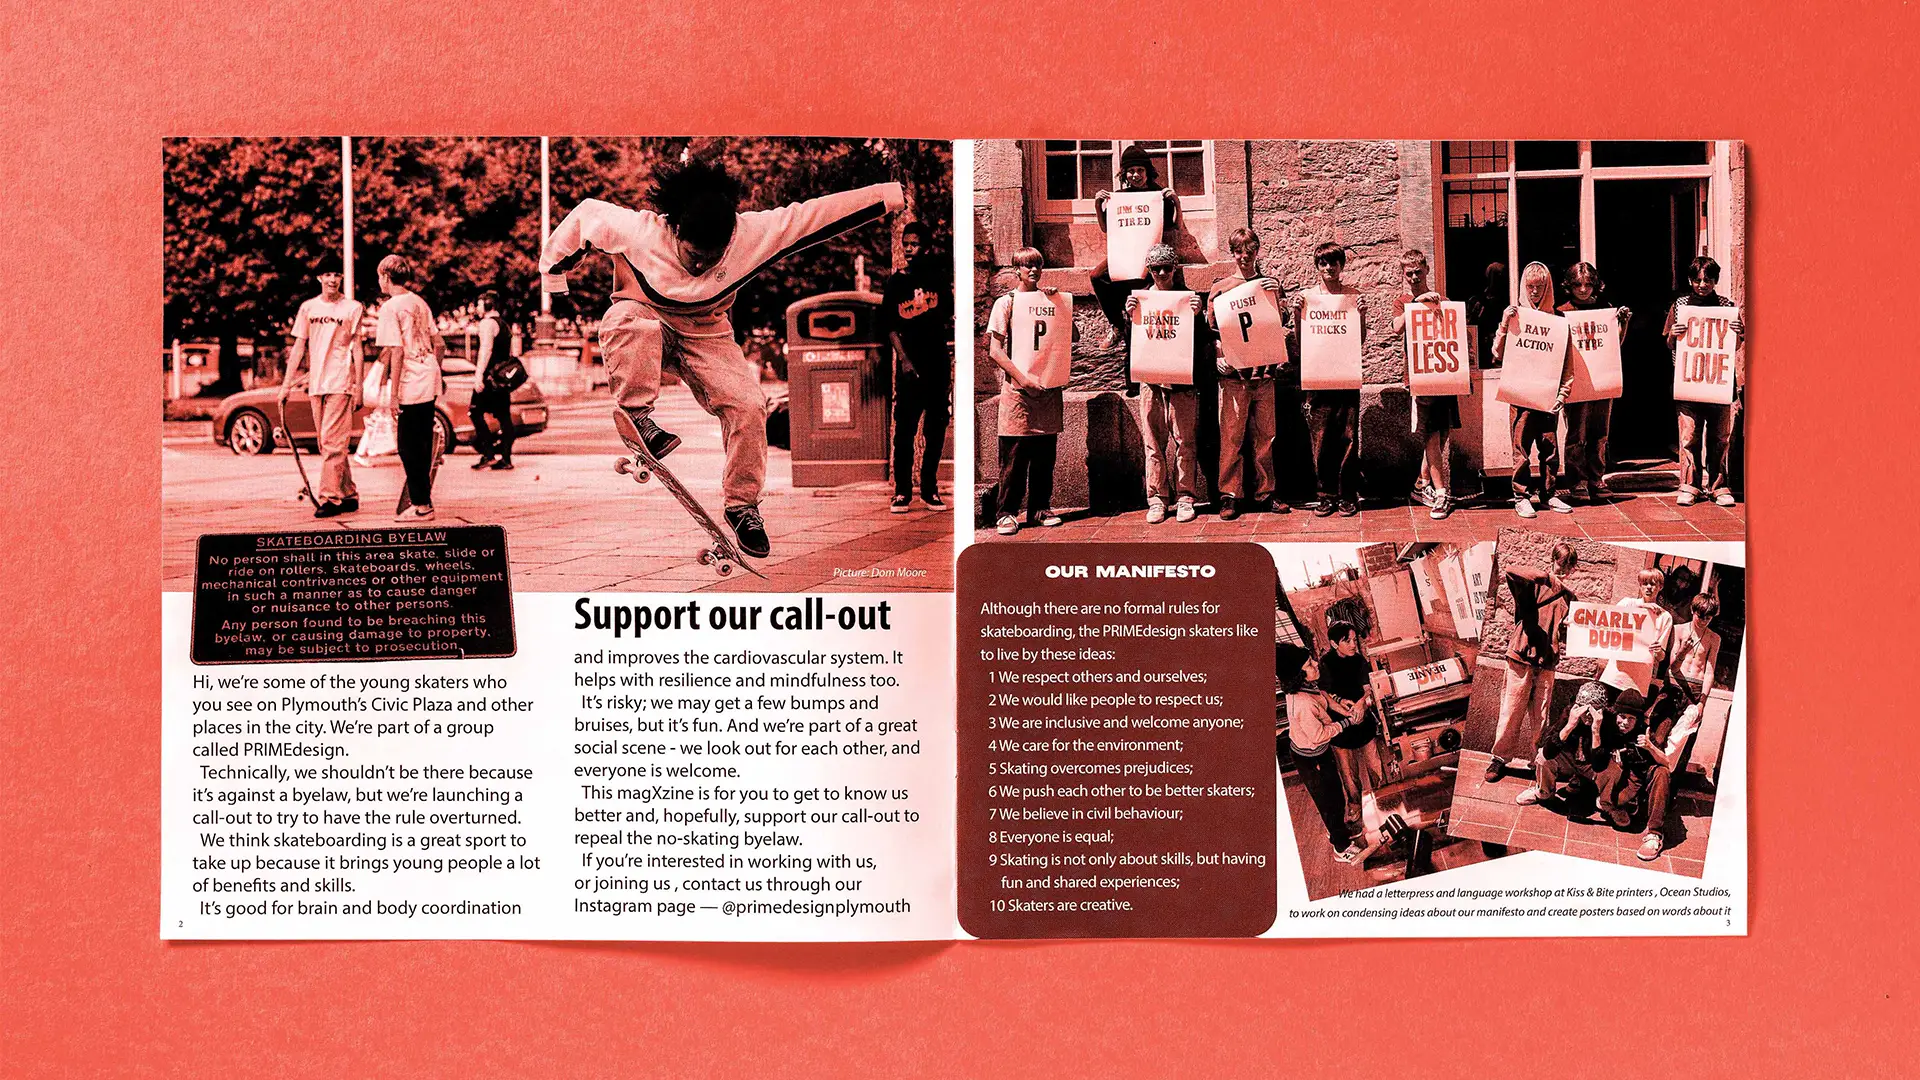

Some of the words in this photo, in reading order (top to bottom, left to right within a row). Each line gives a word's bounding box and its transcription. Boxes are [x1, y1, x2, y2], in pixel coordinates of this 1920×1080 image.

[1118, 217, 1151, 227] TIRED
[1029, 306, 1055, 316] PUSH
[1230, 296, 1256, 310] PUSH
[1143, 315, 1180, 326] BEANIE
[1310, 310, 1348, 320] COMMIT
[1238, 312, 1253, 342] P
[1310, 325, 1347, 335] TRICKS
[1411, 309, 1457, 341] FEAR
[1525, 324, 1550, 336] RAW
[1687, 316, 1729, 349] CITY
[1034, 320, 1047, 351] P
[1146, 329, 1177, 339] WARS
[1516, 338, 1554, 352] ACTION
[1413, 341, 1459, 374] LESS
[256, 533, 382, 547] SKATEBOARDING
[388, 531, 446, 543] BYELAW
[832, 567, 870, 577] Picture:
[870, 567, 894, 577] Dom
[896, 567, 926, 577] Moore
[1044, 565, 1088, 578] OUR
[1096, 564, 1216, 577] MANIFESTO
[227, 591, 239, 601] in
[244, 590, 275, 601] such
[280, 591, 287, 600] a
[292, 590, 342, 599] manner
[347, 589, 362, 598] as
[367, 587, 381, 597] to
[386, 588, 425, 596] cause
[430, 584, 477, 597] danger
[251, 605, 266, 613] or
[271, 601, 330, 613] nuisance
[335, 600, 349, 611] to
[354, 599, 390, 610] other
[396, 599, 453, 611] persons.
[221, 619, 246, 632] Any
[251, 620, 297, 631] person
[302, 616, 342, 627] found
[347, 616, 361, 626] to
[367, 615, 383, 626] be
[388, 613, 455, 627] breaching
[460, 612, 486, 623] this
[574, 597, 700, 638] Support
[708, 606, 762, 630] our
[770, 597, 891, 630] call-out
[1574, 608, 1647, 631] GNARLY
[980, 624, 1075, 640] skateboarding,
[1078, 624, 1100, 637] the
[1102, 624, 1186, 640] PRIMEdesign
[1188, 623, 1233, 636] skaters
[1236, 623, 1258, 636] like
[245, 647, 272, 657] may
[278, 644, 294, 654] be
[299, 642, 350, 655] subject
[355, 642, 369, 652] to
[375, 641, 461, 654] prosecution.
[574, 649, 602, 663] and
[608, 650, 679, 667] improves
[683, 649, 709, 664] the
[713, 650, 826, 664] cardiovascular
[830, 651, 888, 668] system.
[893, 650, 903, 664] It
[574, 671, 616, 689] helps
[620, 672, 653, 686] with
[659, 672, 731, 687] resilience
[735, 672, 764, 687] and
[770, 672, 866, 687] mindfulness
[869, 674, 899, 686] too.
[192, 741, 238, 756] called
[244, 741, 348, 760] PRIMEdesign.
[988, 762, 996, 774] 5
[999, 761, 1047, 777] Skating
[1050, 764, 1120, 774] overcomes
[1124, 761, 1193, 776] prejudices;
[192, 809, 252, 824] call-out
[256, 811, 272, 824] to
[276, 811, 298, 828] try
[302, 811, 318, 824] to
[324, 809, 360, 824] have
[364, 809, 390, 824] the
[395, 809, 425, 824] rule
[429, 809, 521, 824] overturned.
[200, 833, 224, 846] We
[228, 832, 270, 846] think
[273, 832, 386, 850] skateboarding
[391, 833, 402, 846] is
[407, 836, 415, 846] a
[420, 834, 461, 850] great
[465, 834, 506, 850] sport
[510, 834, 526, 846] to
[574, 830, 622, 847] repeal
[626, 830, 652, 844] the
[657, 830, 738, 849] no-skating
[744, 831, 802, 849] byelaw.
[988, 831, 997, 843] 8
[1000, 830, 1060, 846] Everyone
[1062, 830, 1072, 842] is
[1074, 829, 1114, 845] equal;
[192, 877, 209, 892] of
[213, 877, 276, 892] benefits
[280, 877, 309, 892] and
[314, 877, 355, 892] skills.
[1338, 888, 1354, 898] We
[1355, 888, 1375, 898] had
[1384, 888, 1434, 900] letterpress
[1435, 888, 1456, 898] and
[1456, 888, 1503, 900] language
[1504, 887, 1552, 899] workshop
[1554, 889, 1566, 897] at
[1566, 887, 1585, 897] Kiss
[1586, 887, 1594, 897] &
[1596, 887, 1614, 897] Bite
[1615, 887, 1653, 898] printers
[1659, 887, 1691, 897] Ocean
[1692, 886, 1731, 898] Studios,
[574, 898, 652, 916] Instagram
[657, 902, 695, 916] page
[722, 898, 910, 917] @primedesignplymouth
[990, 899, 1005, 911] 10
[1008, 898, 1054, 911] Skaters
[1056, 901, 1077, 911] are
[1080, 898, 1133, 910] creative.
[1289, 909, 1299, 918] to
[1301, 908, 1325, 917] work
[1341, 907, 1398, 919] condensing
[1399, 907, 1425, 917] ideas
[1426, 907, 1456, 917] about
[1476, 906, 1525, 916] manifesto
[1526, 906, 1546, 916] and
[1547, 908, 1578, 916] create
[1578, 908, 1614, 918] posters
[1616, 906, 1646, 916] based
[1646, 908, 1660, 916] on
[1662, 906, 1691, 916] words
[1692, 905, 1722, 915] about
[1724, 906, 1731, 915] it
